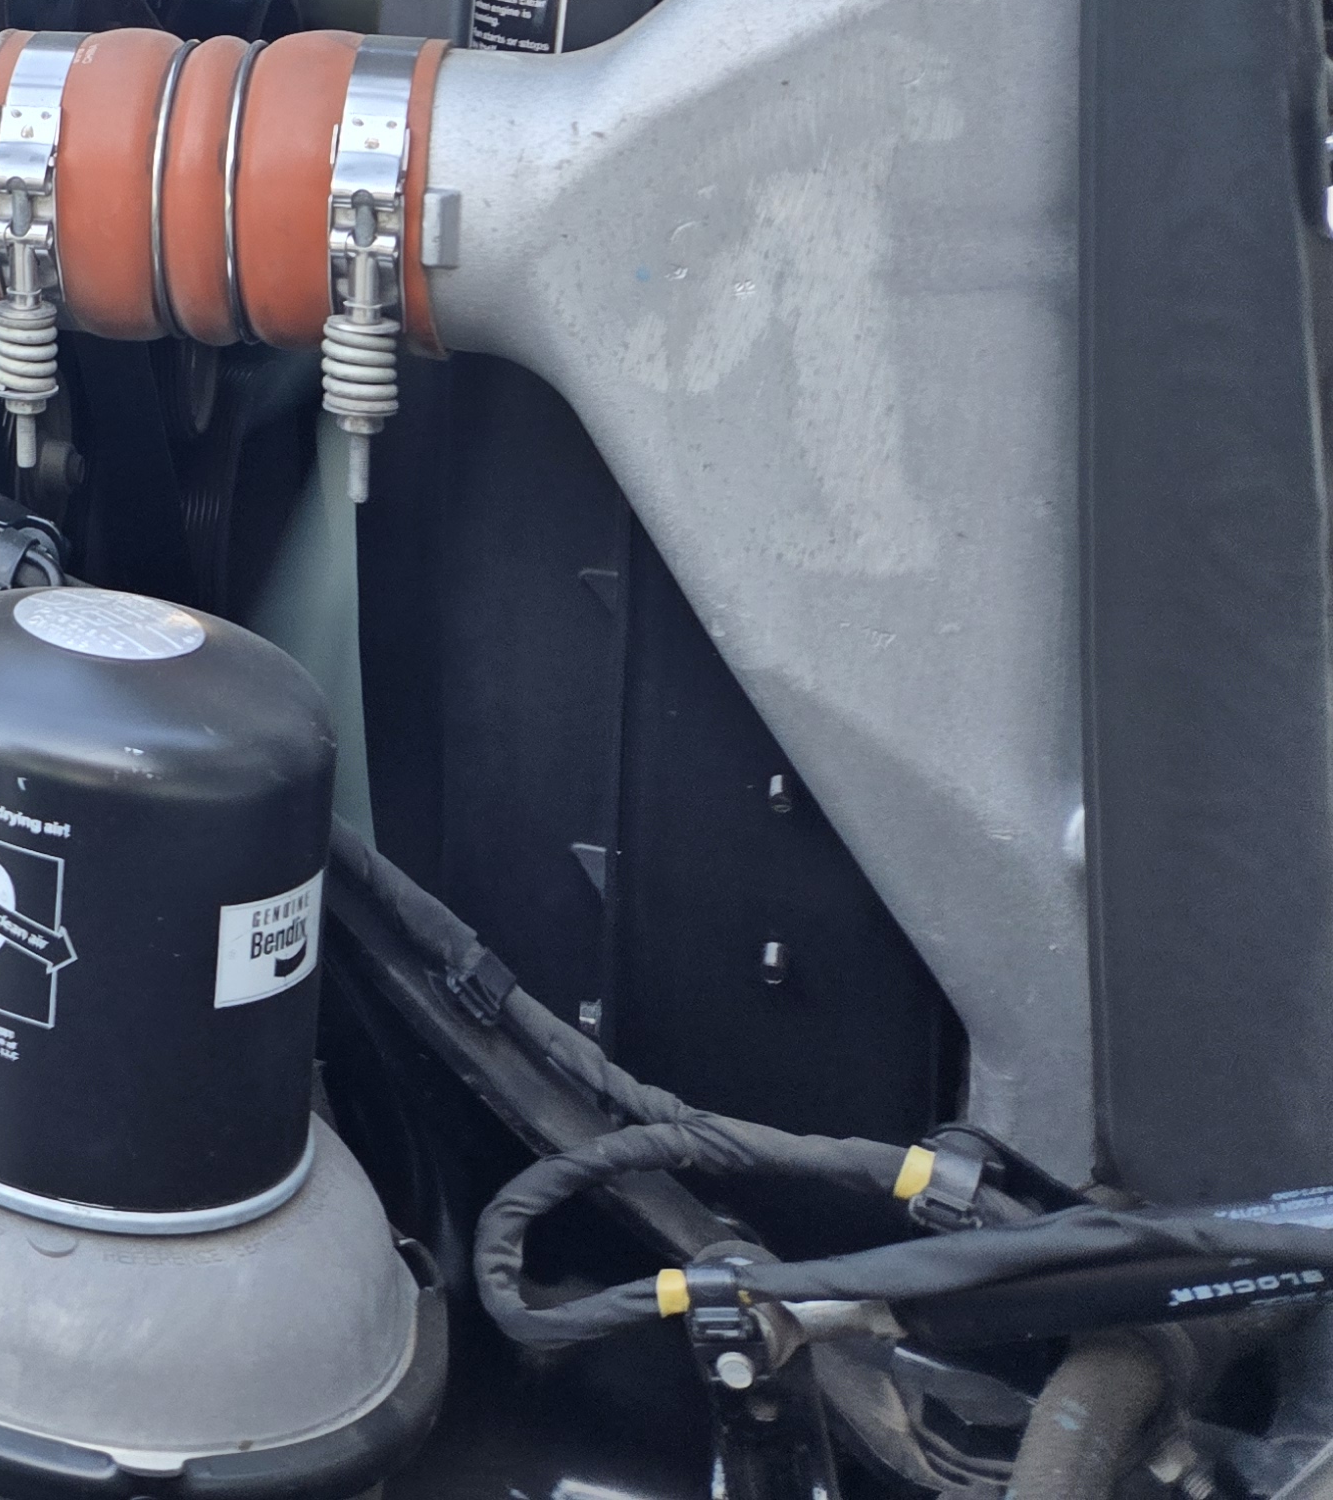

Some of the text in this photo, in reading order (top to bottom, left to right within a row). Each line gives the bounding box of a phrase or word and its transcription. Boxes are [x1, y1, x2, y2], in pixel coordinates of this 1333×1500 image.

[491, 4, 521, 17] engine
[521, 8, 532, 19] is
[518, 39, 550, 51] stops
[252, 889, 312, 929] GENUINE
[27, 933, 50, 950] air
[250, 915, 308, 960] Bendix
